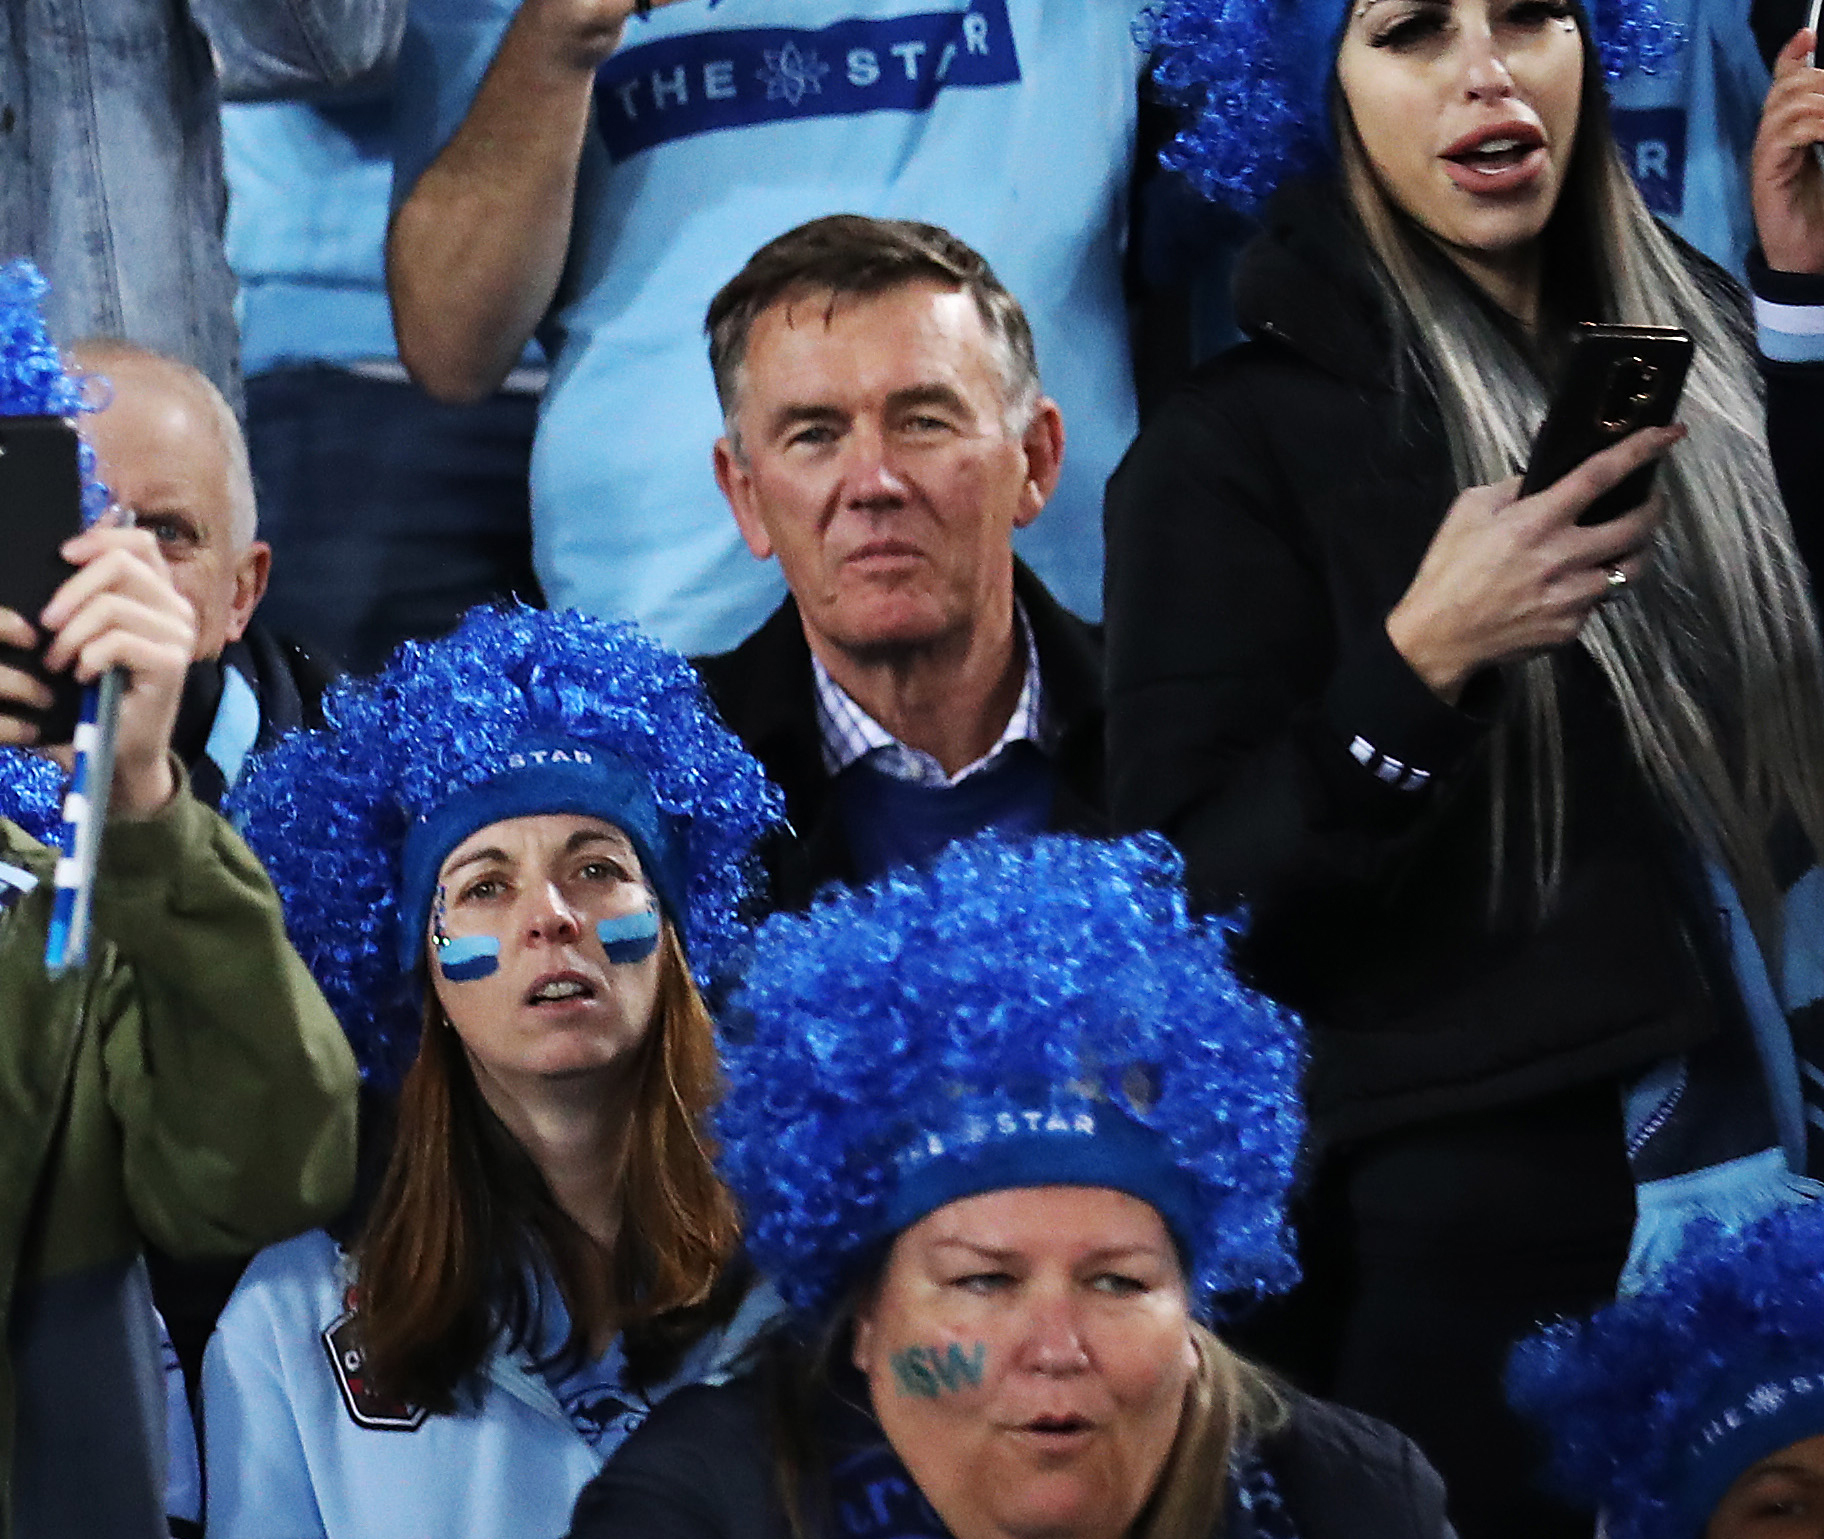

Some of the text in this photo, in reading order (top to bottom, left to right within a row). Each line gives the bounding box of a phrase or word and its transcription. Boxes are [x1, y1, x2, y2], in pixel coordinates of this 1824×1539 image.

[615, 61, 737, 119] THE
[508, 748, 593, 769] STAR
[997, 1110, 1095, 1136] STAR
